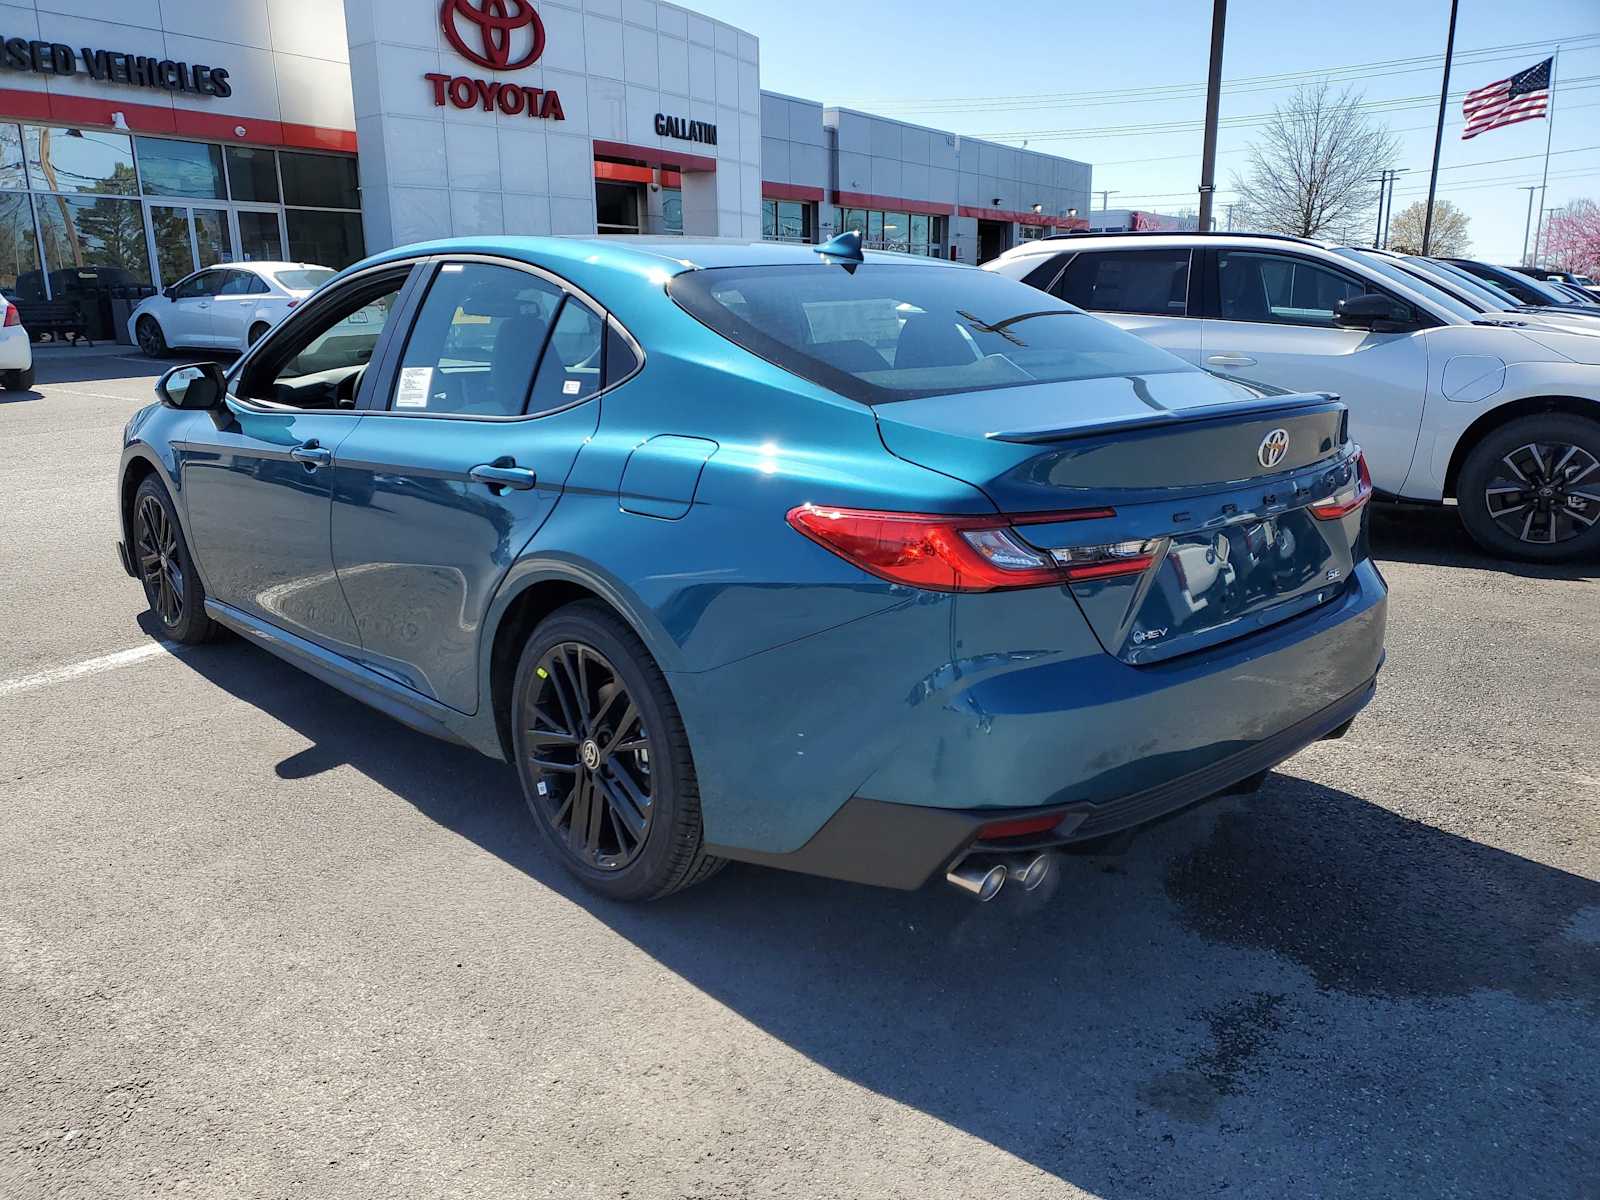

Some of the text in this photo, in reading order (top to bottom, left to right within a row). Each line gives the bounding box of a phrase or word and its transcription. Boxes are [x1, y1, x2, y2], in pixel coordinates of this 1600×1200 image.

[0, 35, 232, 98] SED VEHICLES
[425, 73, 565, 120] TOYOTA
[655, 112, 718, 146] GALLATIN
[1327, 568, 1341, 581] SE
